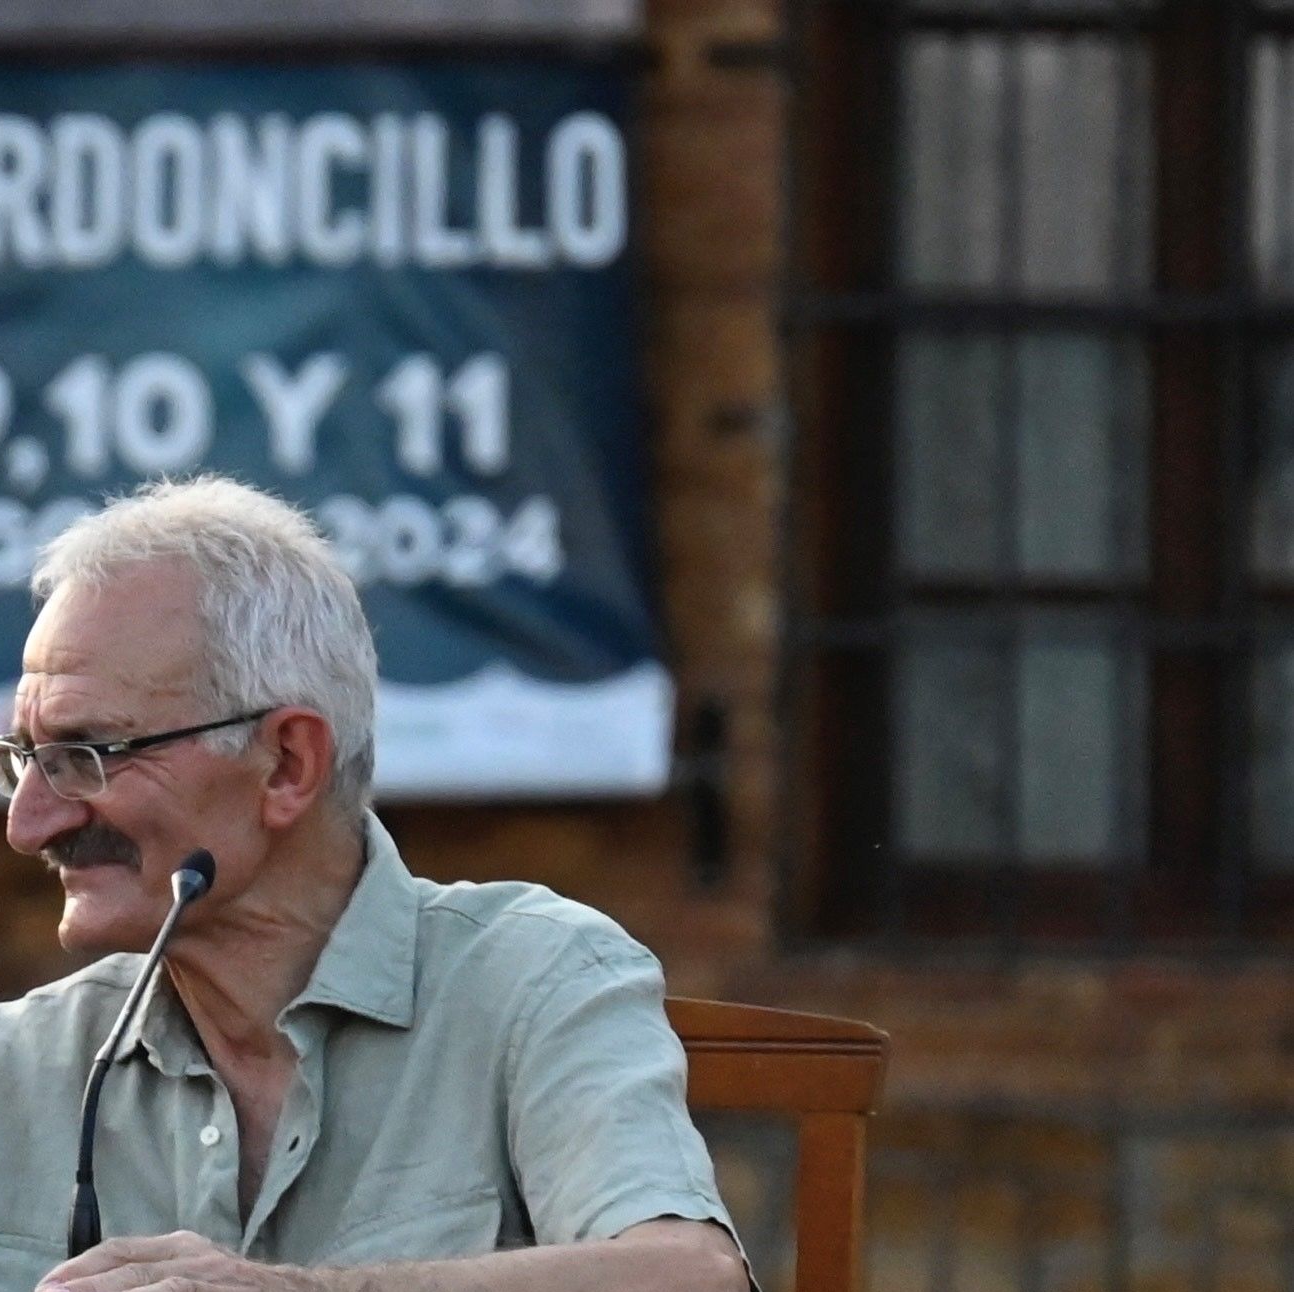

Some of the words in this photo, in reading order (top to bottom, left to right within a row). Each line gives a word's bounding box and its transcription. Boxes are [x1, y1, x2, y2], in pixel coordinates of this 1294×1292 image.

[239, 351, 349, 474] Y
[379, 351, 511, 477] 11
[317, 495, 564, 588] 2024
